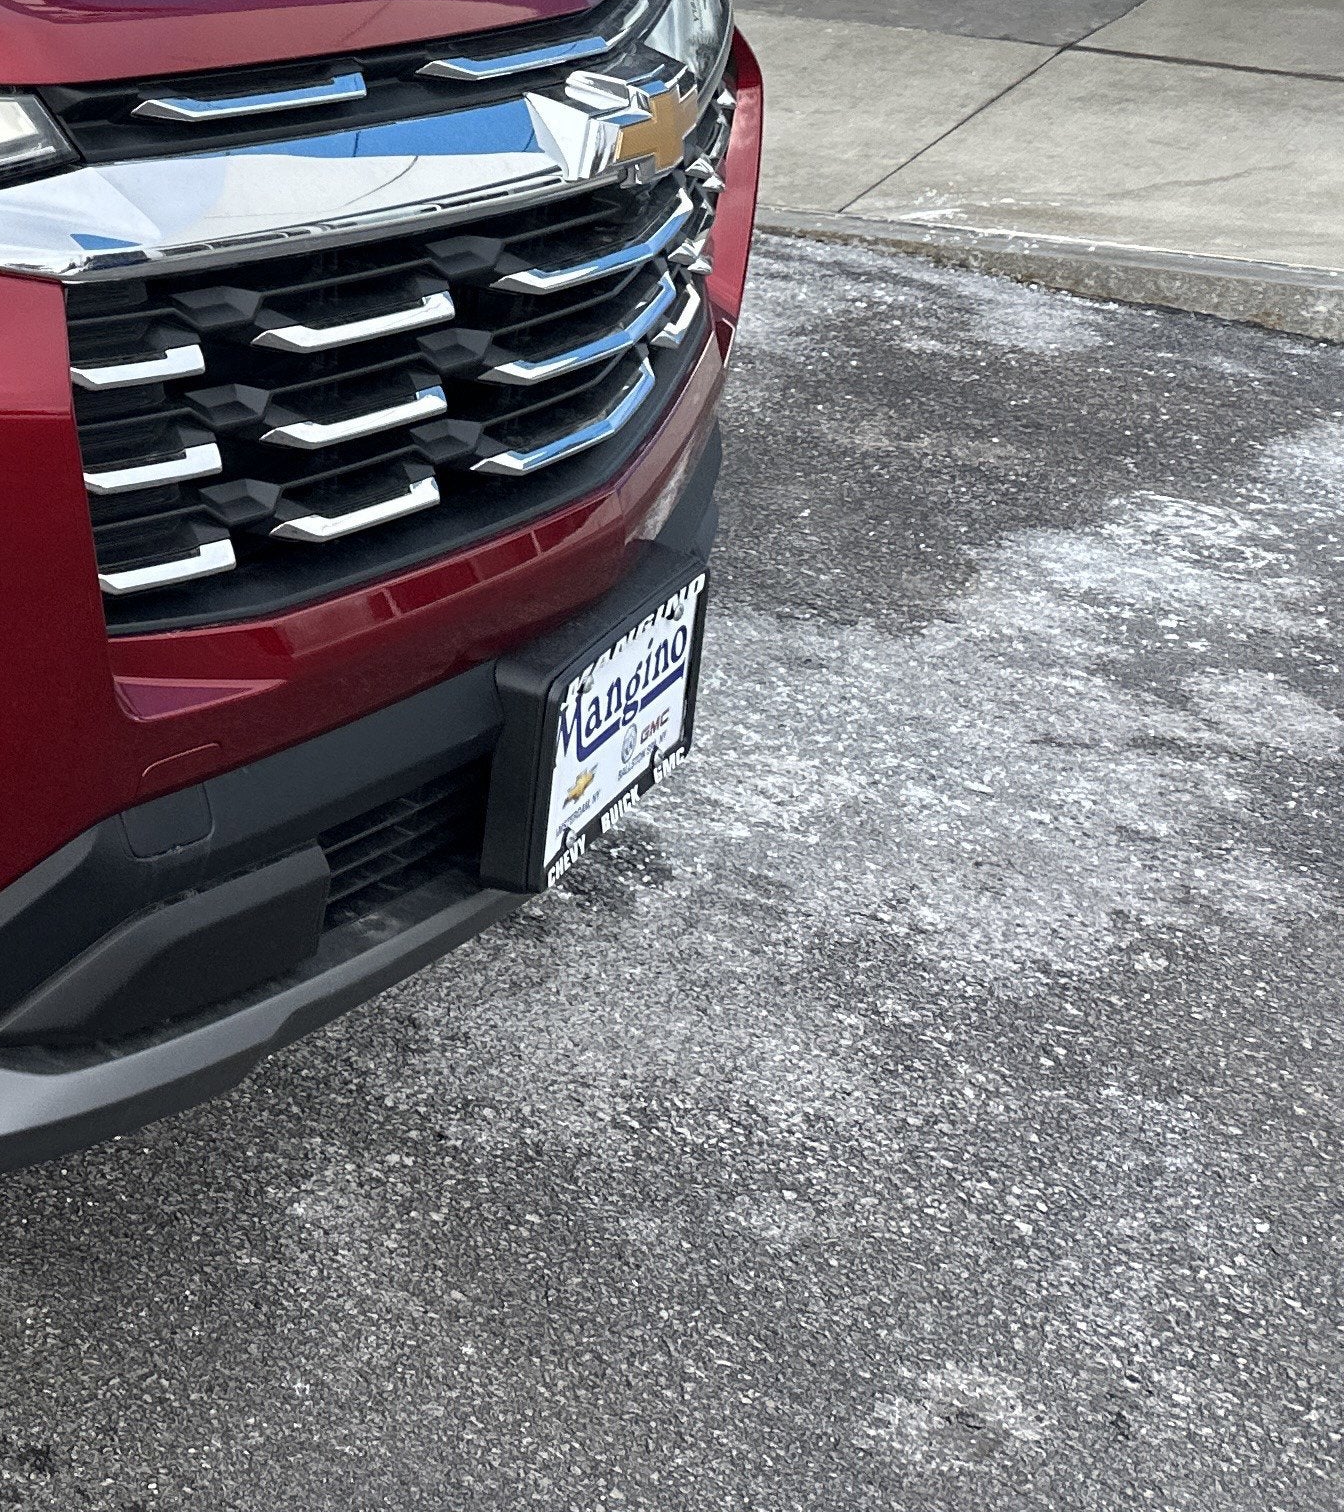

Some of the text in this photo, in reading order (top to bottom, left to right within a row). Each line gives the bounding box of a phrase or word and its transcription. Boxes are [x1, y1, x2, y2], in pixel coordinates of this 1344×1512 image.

[558, 624, 688, 763] Mangino
[640, 707, 670, 745] GMC
[547, 746, 686, 888] CHEVY BUICK GMC
